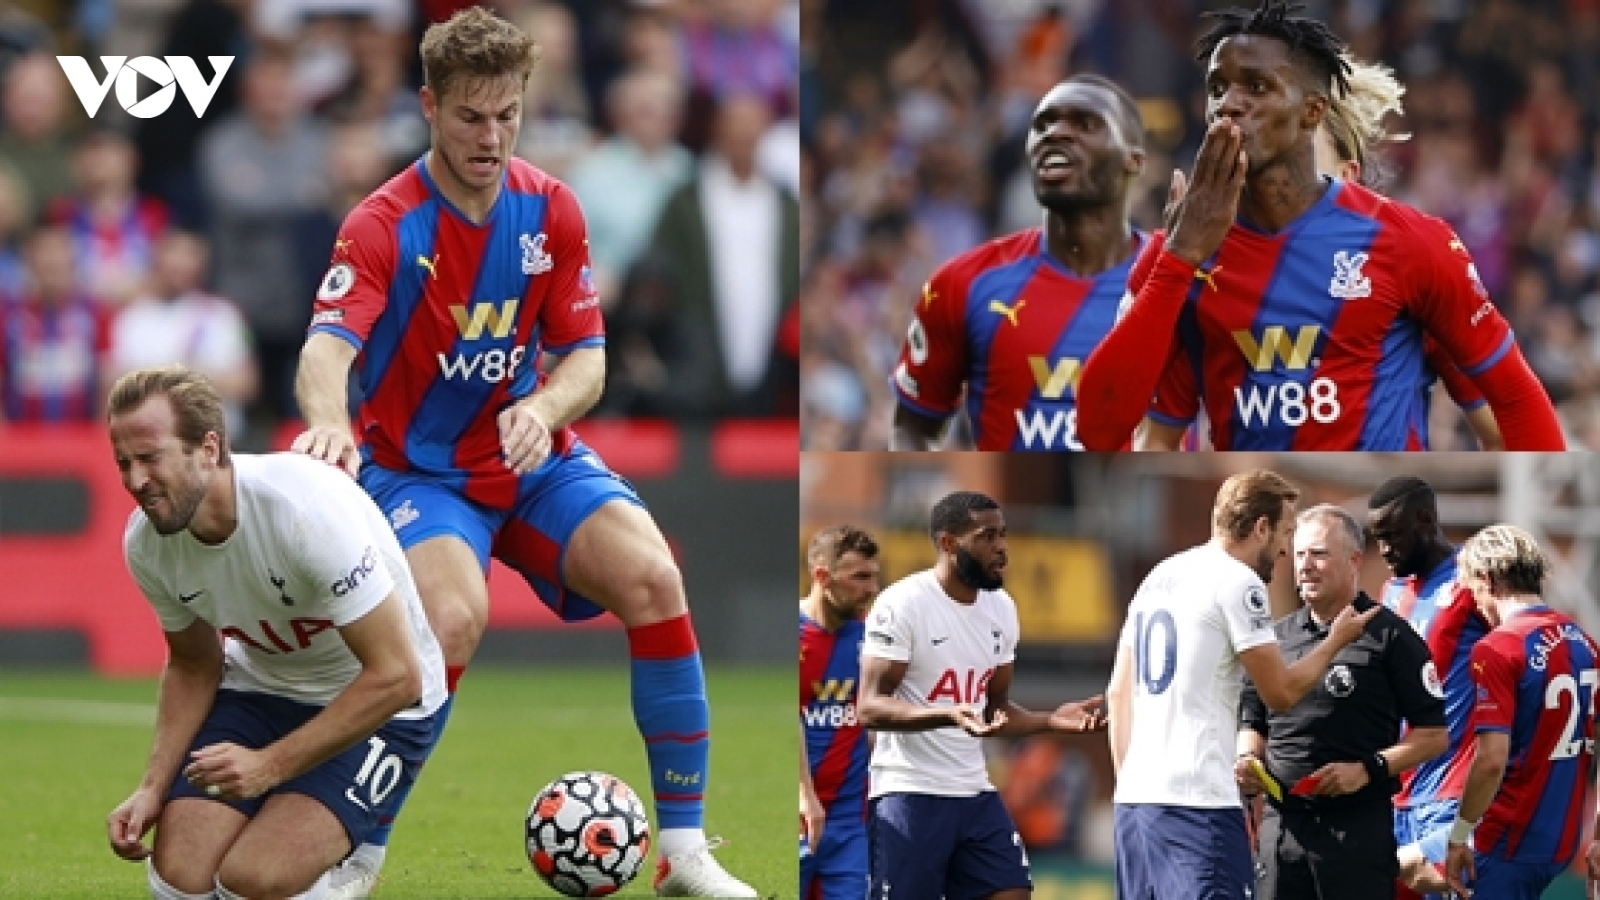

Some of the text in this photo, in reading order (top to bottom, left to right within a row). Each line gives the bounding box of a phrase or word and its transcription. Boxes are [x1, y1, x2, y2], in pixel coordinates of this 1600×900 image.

[1233, 377, 1341, 427] W88
[1133, 608, 1178, 695] 10
[353, 736, 403, 805] 10
